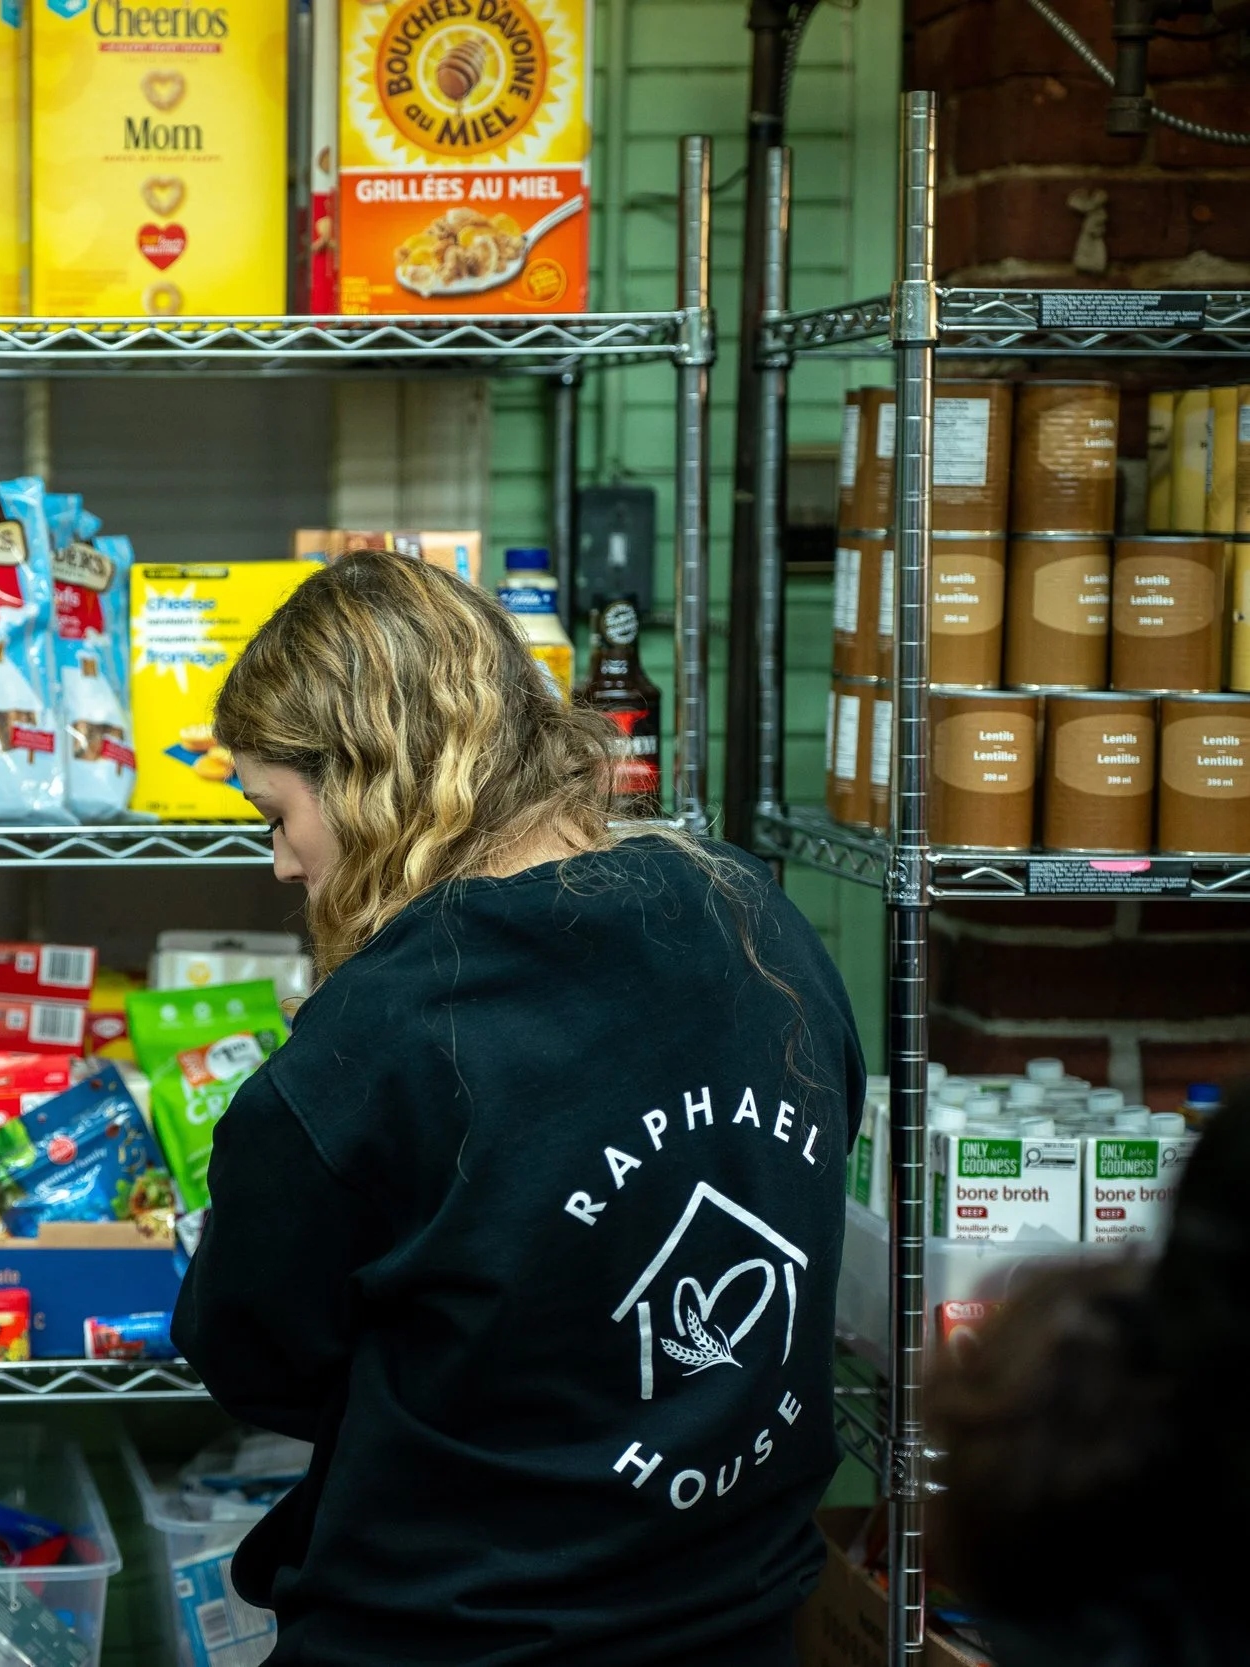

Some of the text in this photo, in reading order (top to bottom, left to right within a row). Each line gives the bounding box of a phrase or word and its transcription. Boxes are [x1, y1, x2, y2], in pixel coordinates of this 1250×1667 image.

[92, 0, 229, 38] Cheerios
[403, 103, 517, 147] au MIEL
[124, 116, 203, 150] Mom
[356, 174, 564, 203] GRILLÉES AU MIEL
[939, 573, 976, 585] Lentils
[1134, 574, 1171, 586] Lentils
[934, 592, 980, 605] Lentilles
[1130, 595, 1175, 607] Lentilles
[979, 730, 1015, 742] Lentils
[1102, 733, 1138, 745] Lentils
[1202, 735, 1240, 746] Lentils
[973, 750, 1018, 762] Lentilles
[1096, 753, 1141, 765] Lentilles
[1196, 755, 1244, 767] Lentilles
[564, 1086, 819, 1226] RAPHAEL
[963, 1141, 989, 1159] ONLY
[1100, 1142, 1126, 1160] ONLY
[956, 1184, 1050, 1202] bone broth
[1095, 1186, 1136, 1203] bone
[960, 1207, 985, 1217] BEEF
[1100, 1209, 1123, 1218] BEEF
[612, 1390, 802, 1510] HOUSE
